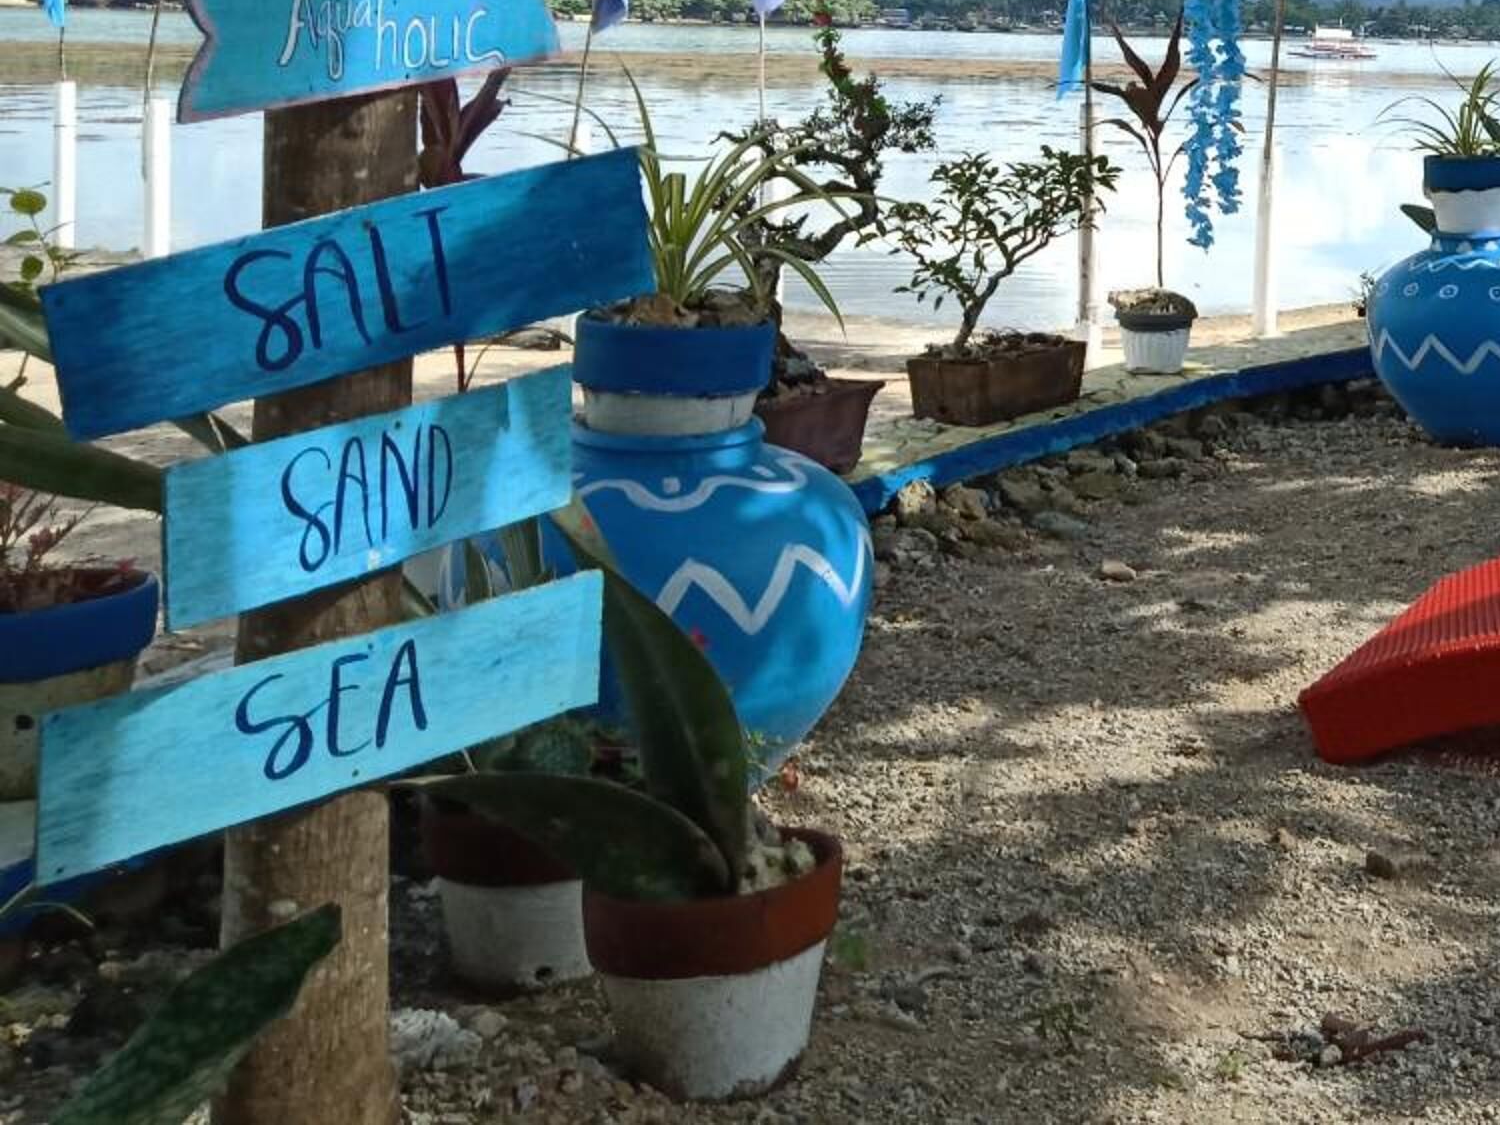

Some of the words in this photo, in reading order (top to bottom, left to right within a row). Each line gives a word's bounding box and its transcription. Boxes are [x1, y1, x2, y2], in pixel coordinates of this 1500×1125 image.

[223, 206, 451, 371] SALT
[280, 424, 453, 572] SAND
[234, 639, 428, 780] SEA
